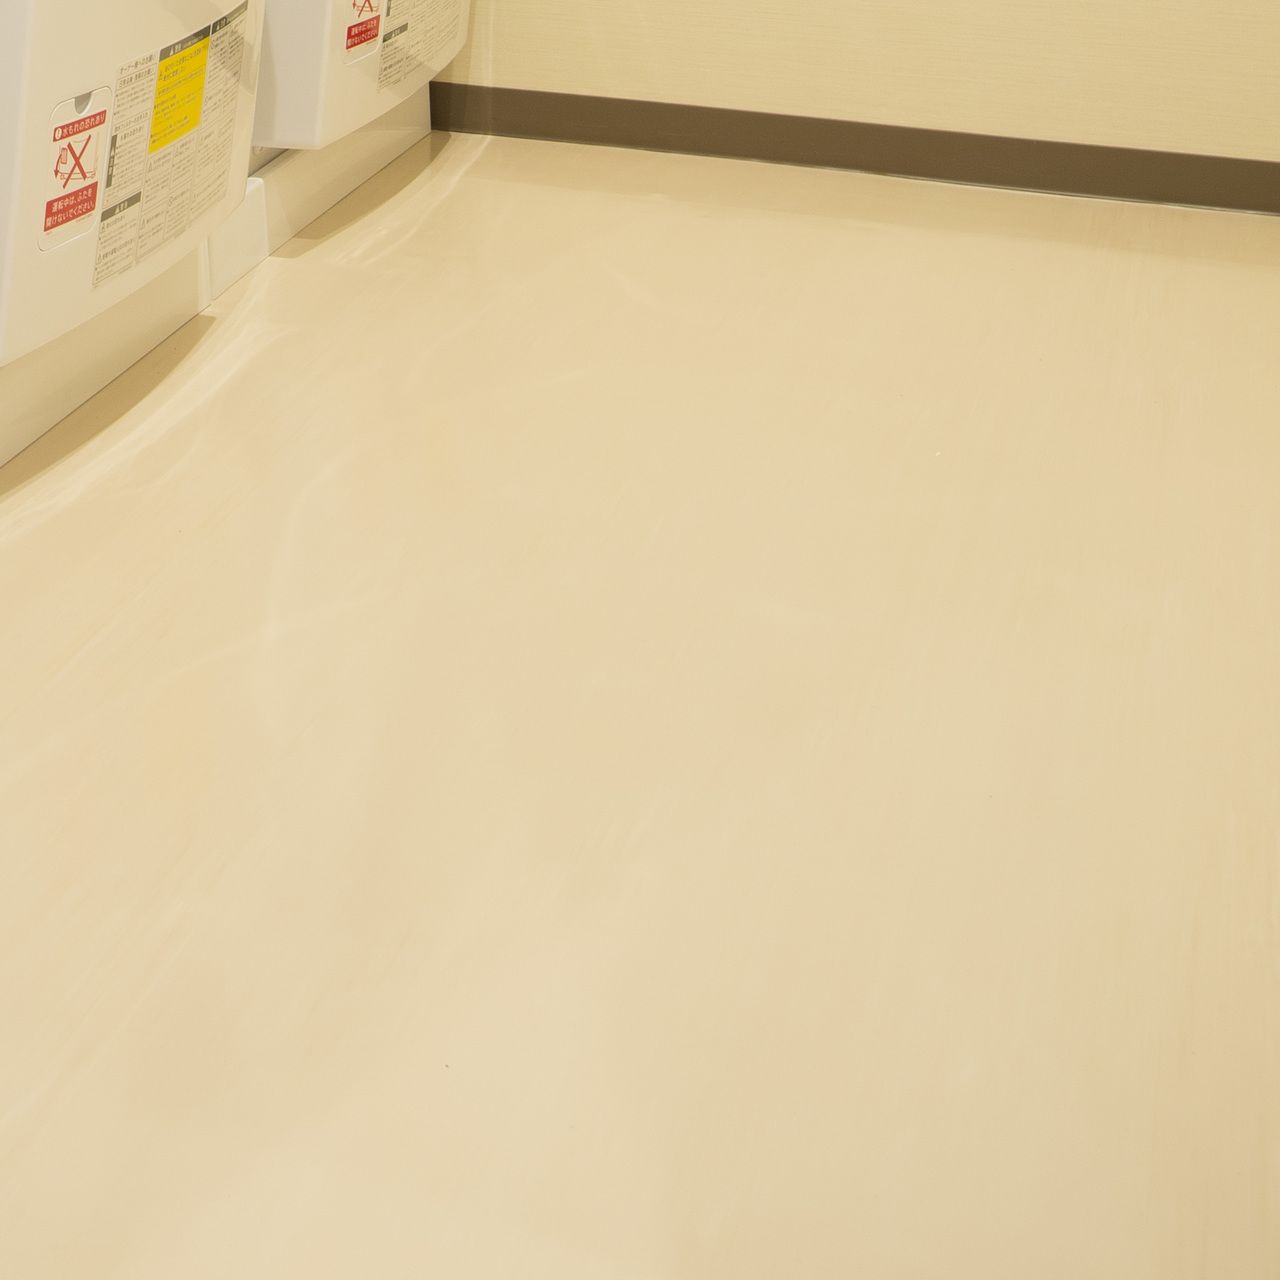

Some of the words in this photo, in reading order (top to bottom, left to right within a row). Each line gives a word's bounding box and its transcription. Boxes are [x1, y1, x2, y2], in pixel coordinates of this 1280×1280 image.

[63, 113, 105, 137] 水もれの恐れあり
